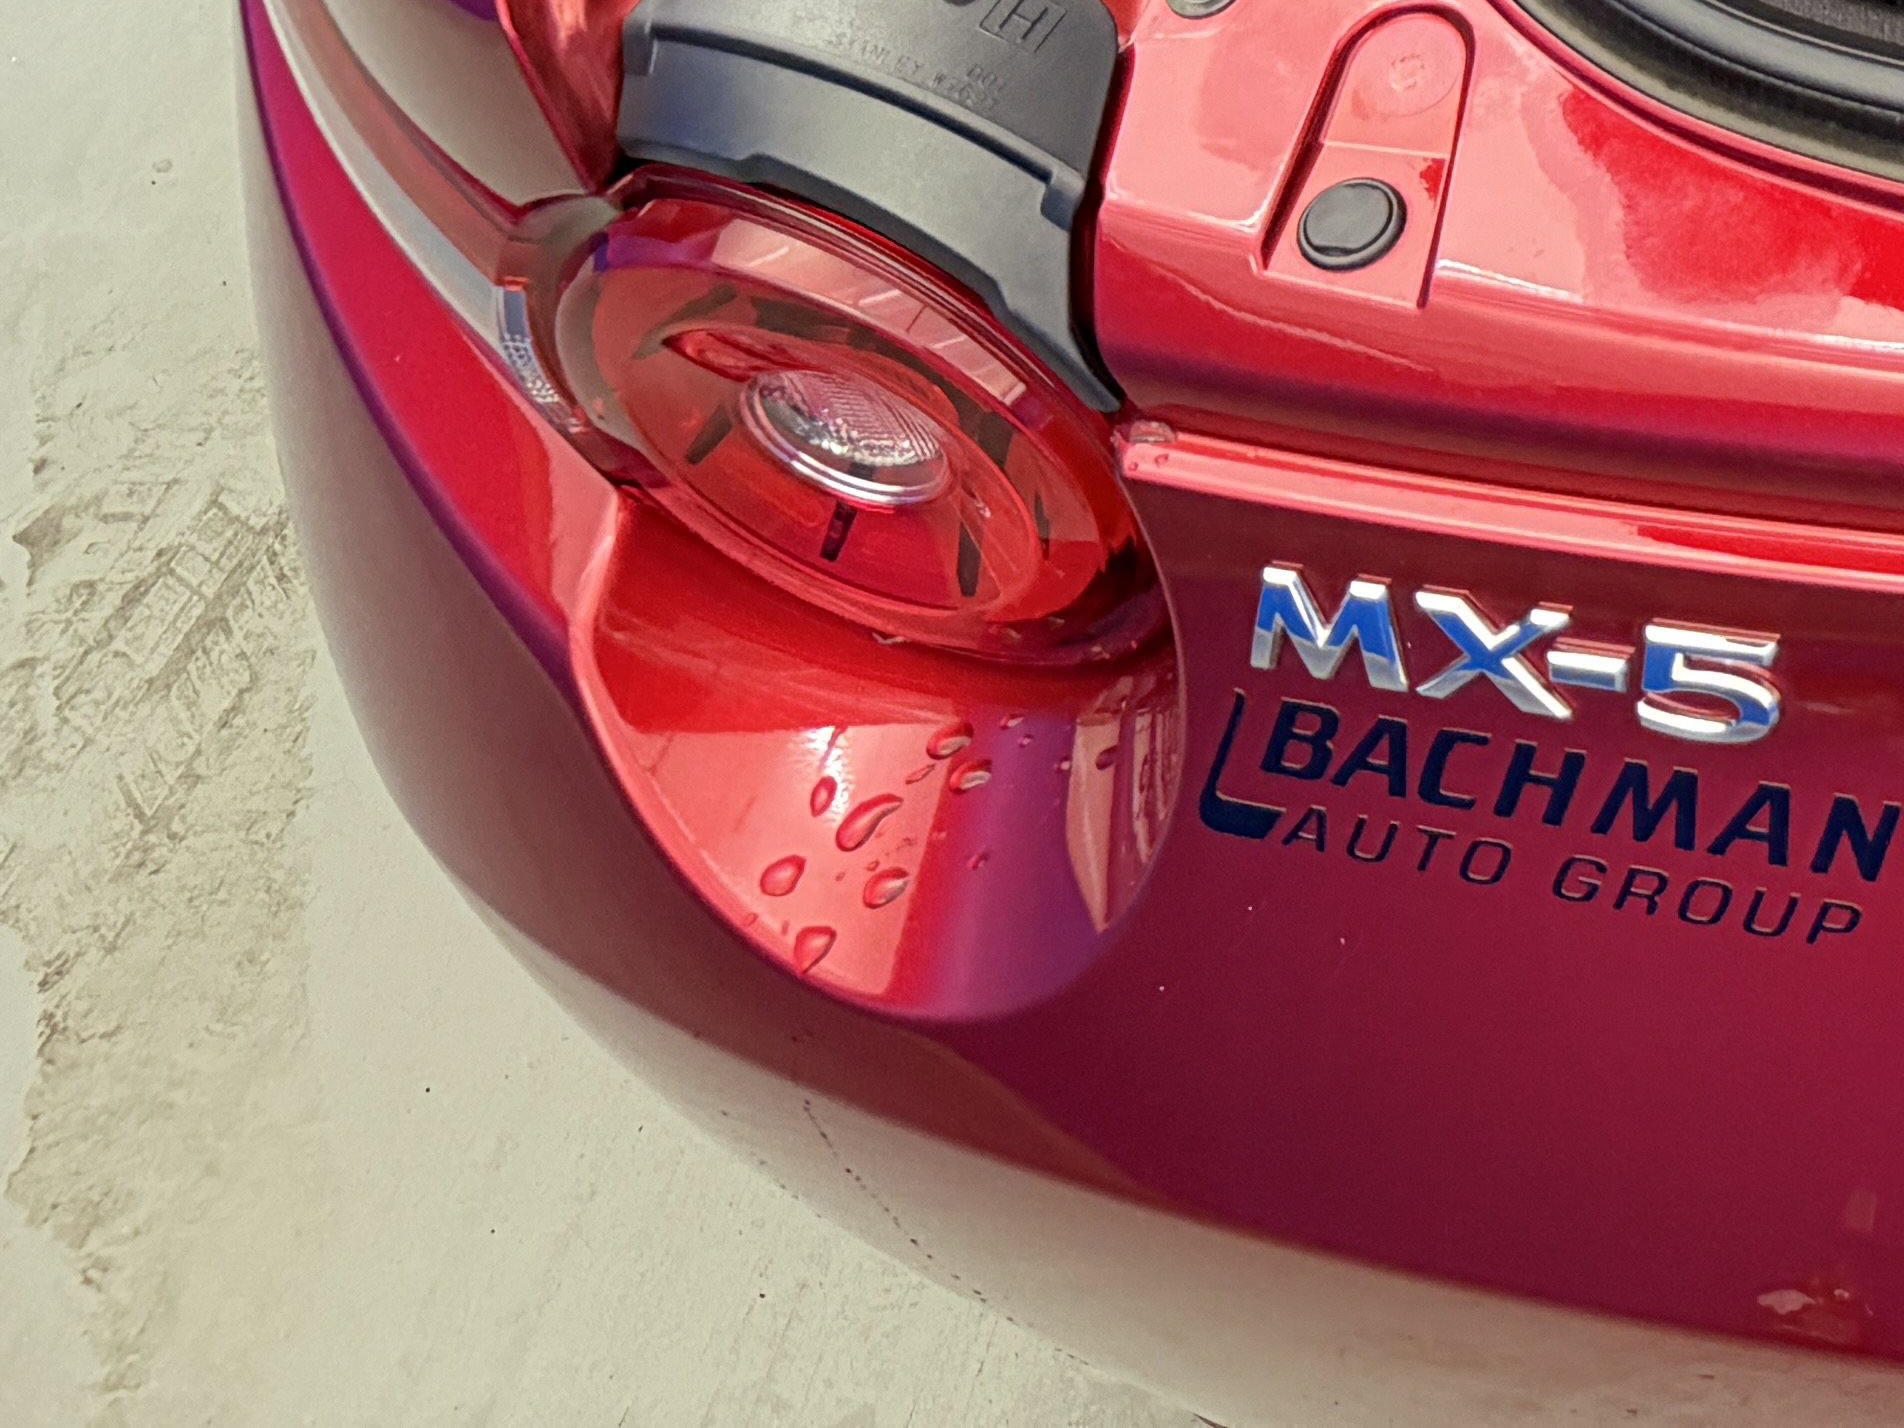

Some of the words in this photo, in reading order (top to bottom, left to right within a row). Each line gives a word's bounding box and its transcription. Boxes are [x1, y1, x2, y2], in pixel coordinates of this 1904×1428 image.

[1248, 560, 1782, 745] MX-5
[1259, 698, 1903, 883] BACHMAN
[1281, 804, 1514, 887] AUTO
[1552, 853, 1865, 947] GROUP
